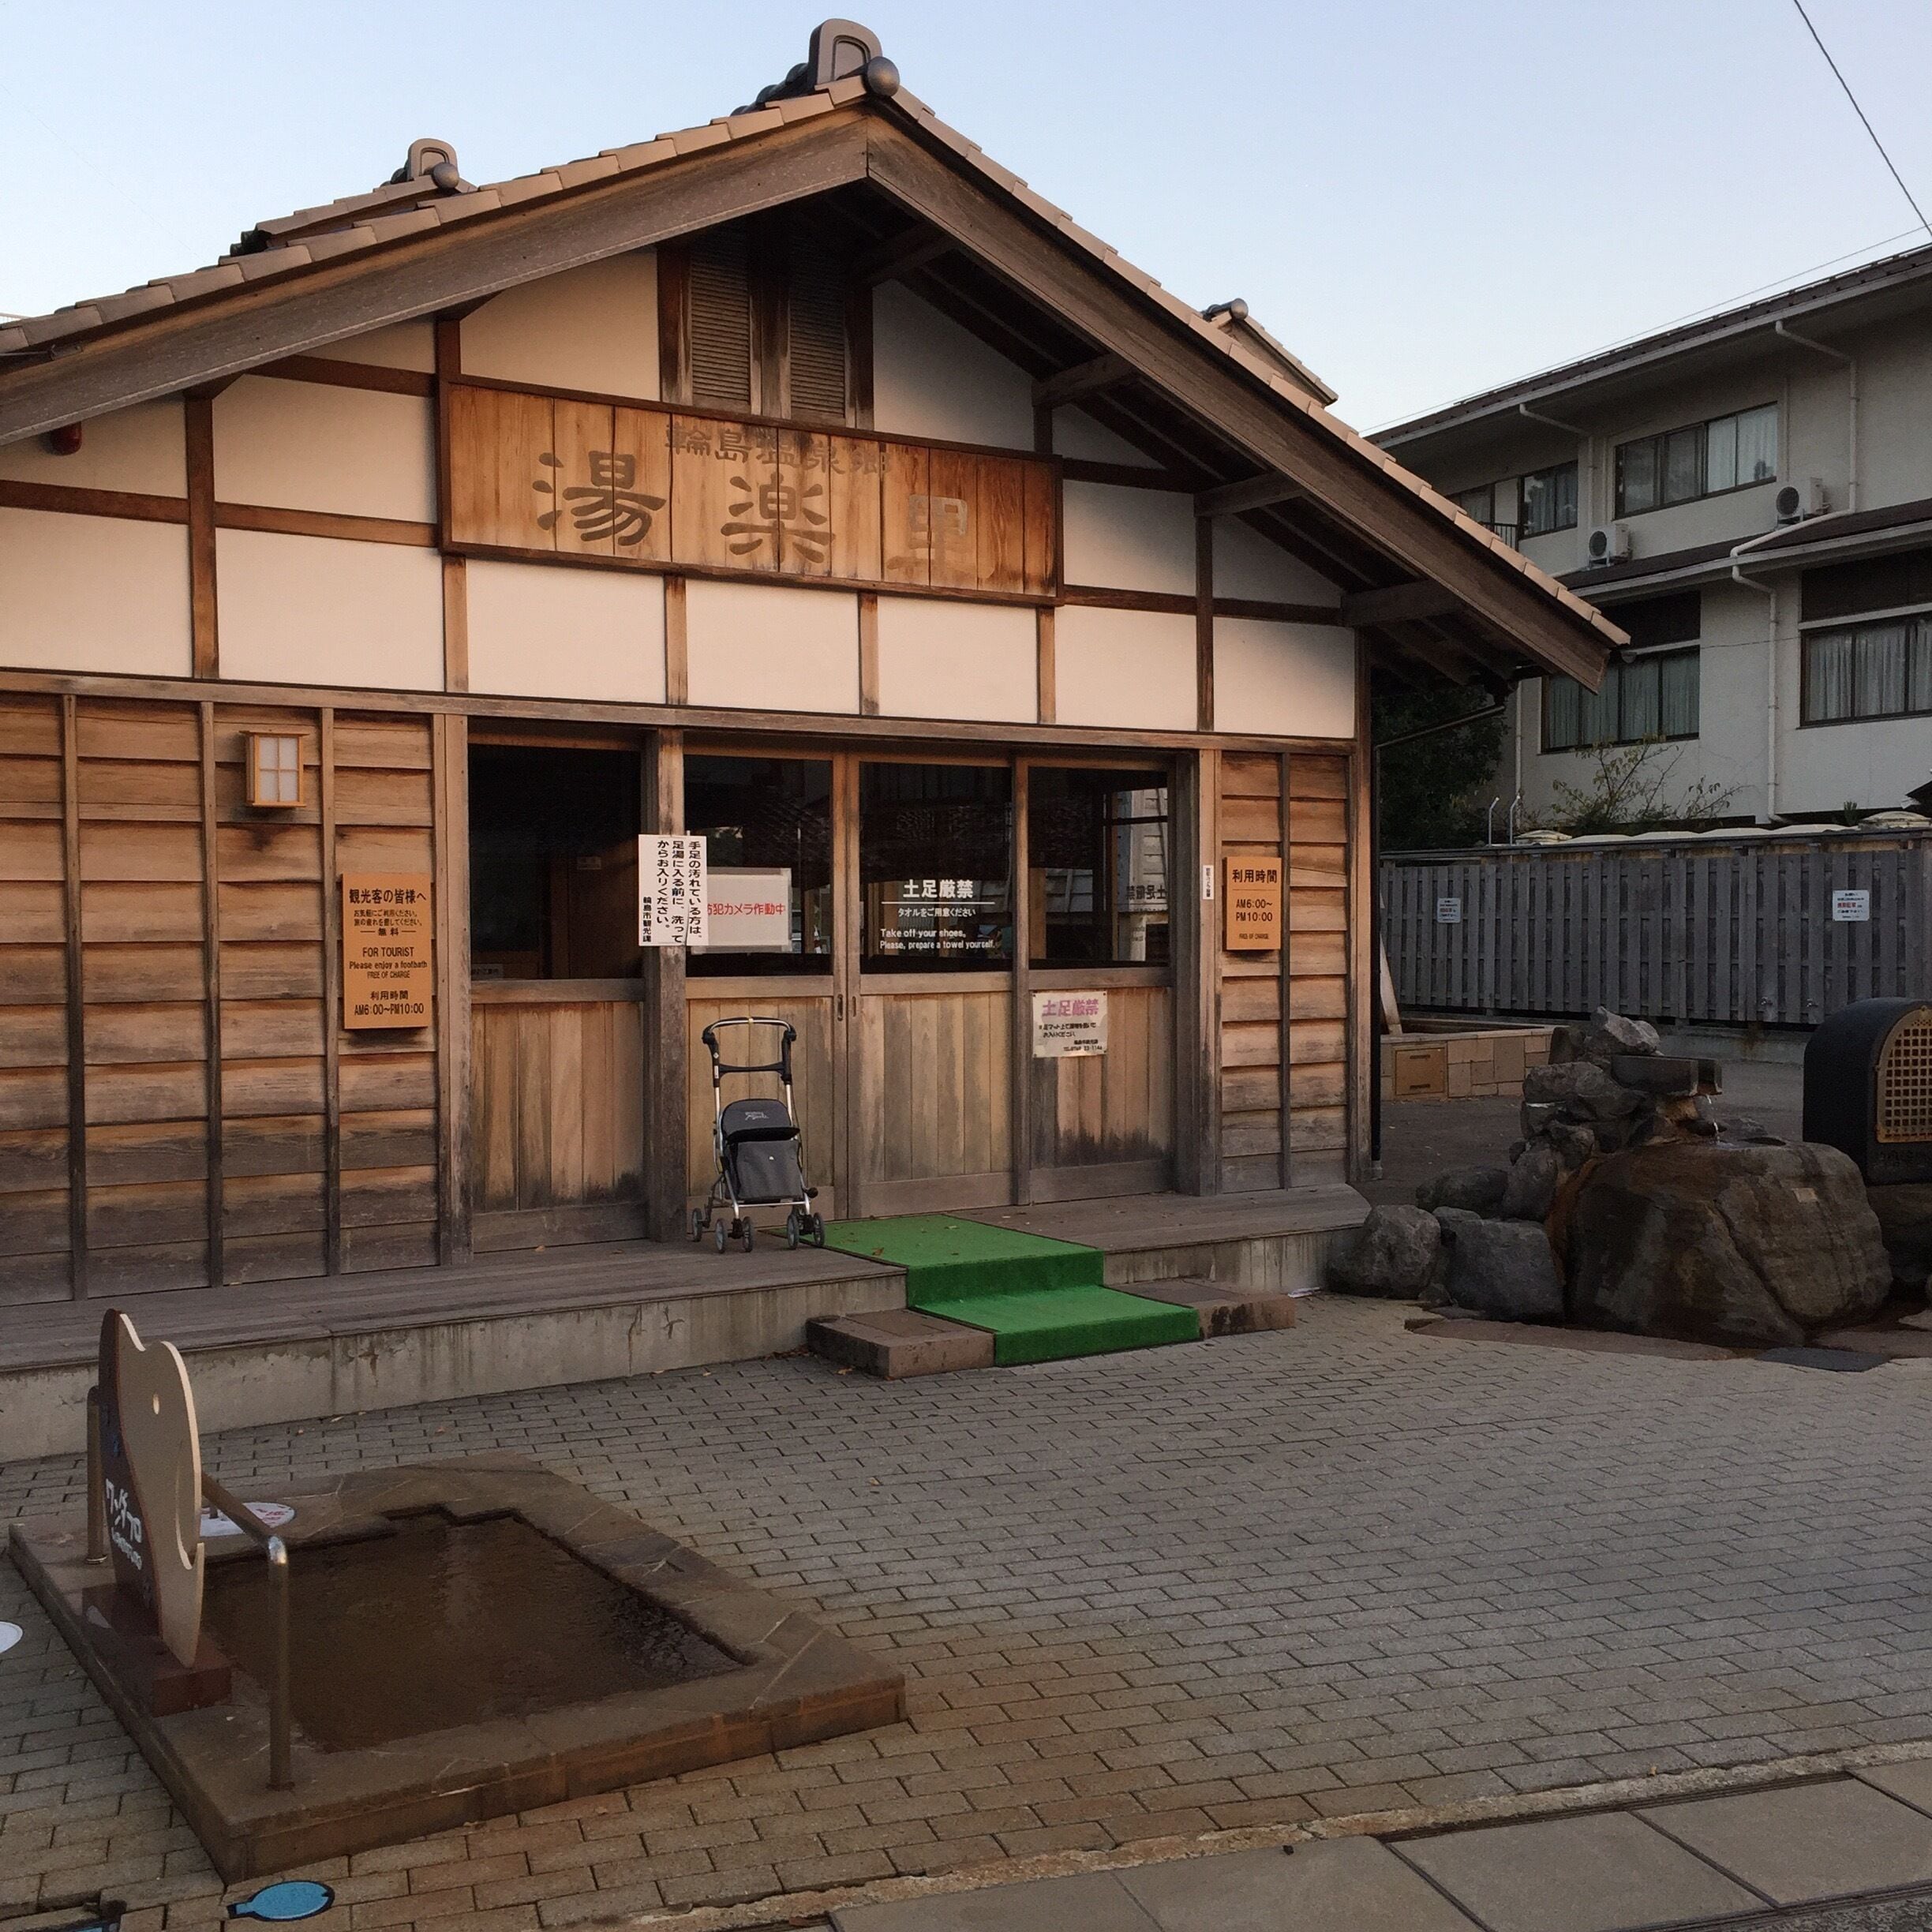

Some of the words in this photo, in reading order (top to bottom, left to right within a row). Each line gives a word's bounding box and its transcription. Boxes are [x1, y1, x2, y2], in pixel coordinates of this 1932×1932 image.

[530, 448, 994, 580] 湯楽里
[1232, 869, 1278, 883] 利用時間
[657, 840, 670, 929] からお入りください。
[688, 841, 702, 938] 手足の汚れている方は、
[902, 878, 974, 899] 土足厳禁
[349, 889, 427, 904] 観光客の皆様へ
[672, 840, 685, 944] 足湯に入る前に、洗って
[898, 908, 976, 918] タオルをご用意ください
[1236, 912, 1273, 922] PM10:00
[880, 928, 902, 938] Take
[904, 928, 916, 938] off
[917, 930, 937, 939] your
[939, 929, 967, 938] shoes,
[362, 947, 379, 957] FOR
[880, 941, 906, 950] Please,
[908, 942, 934, 952] prepare
[965, 941, 995, 951] yourself.
[349, 960, 373, 970] Please
[374, 960, 393, 970] enjoy
[400, 960, 428, 969] footbath
[367, 971, 380, 979] FREE
[382, 971, 390, 979] OF
[370, 990, 409, 1001] 利用時間
[1042, 998, 1099, 1017] 土足厳禁
